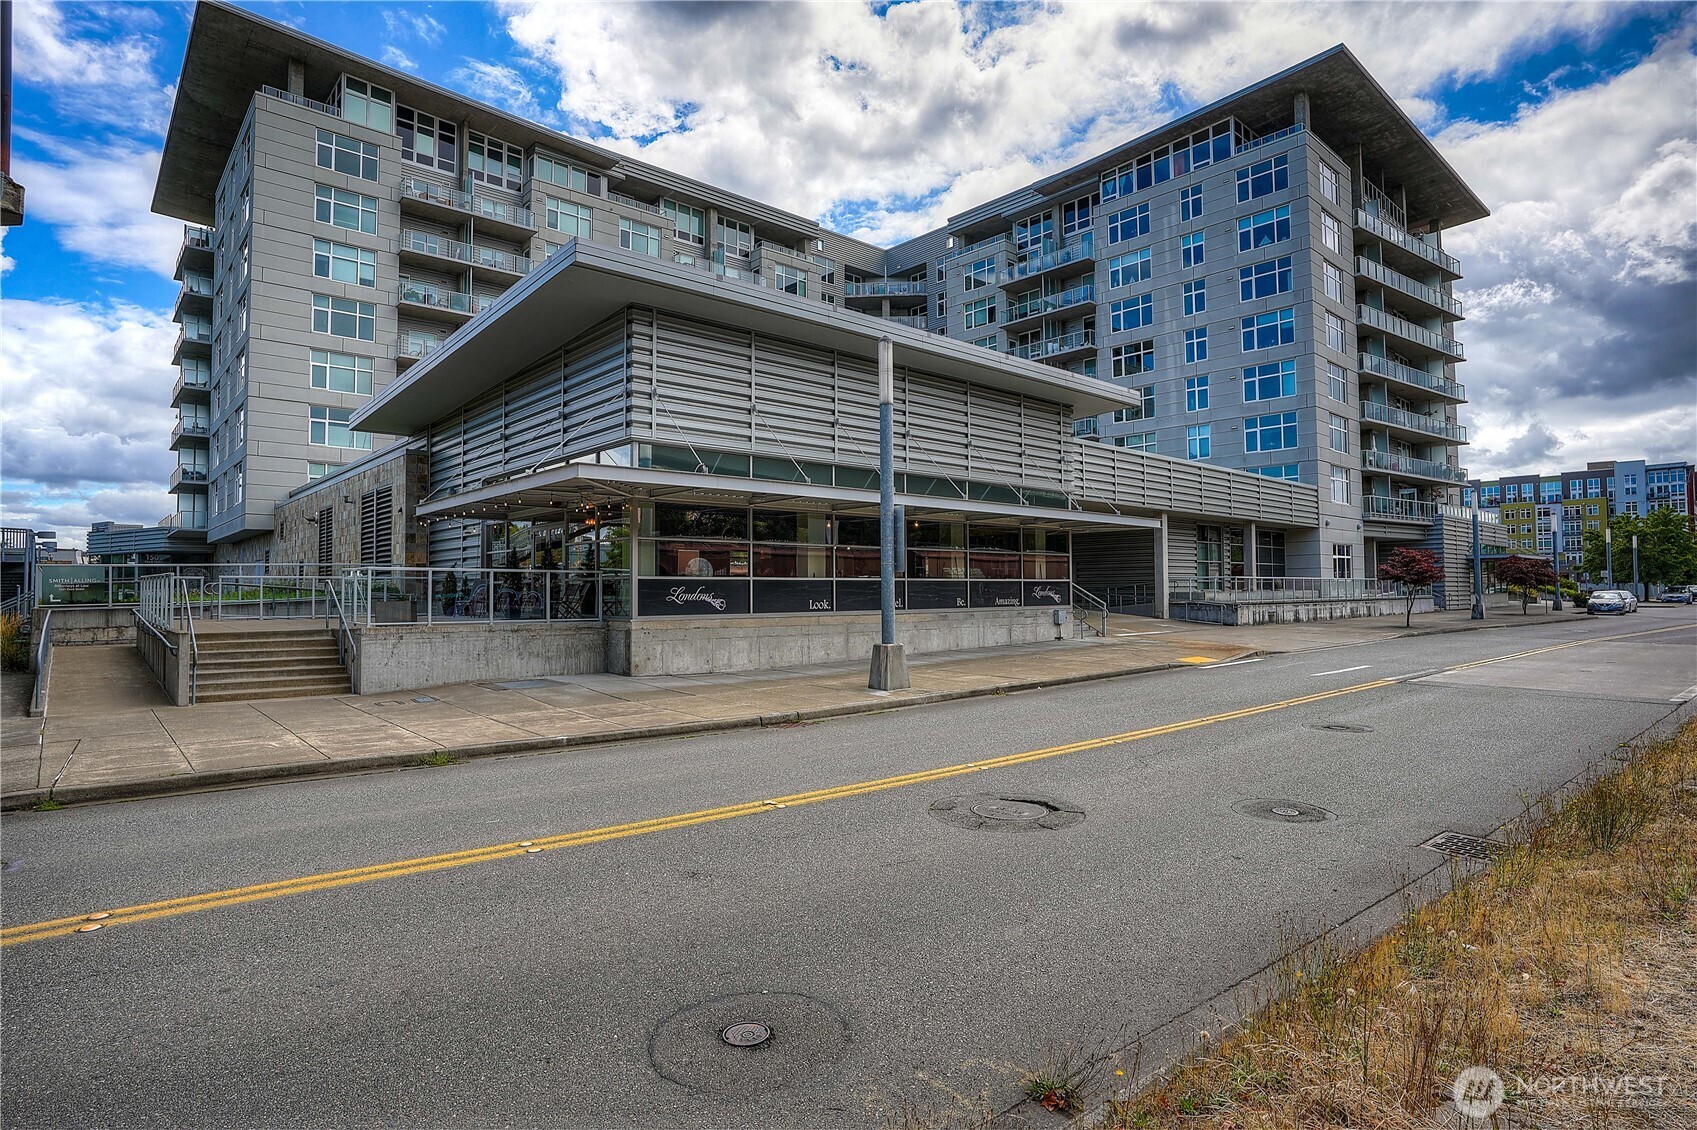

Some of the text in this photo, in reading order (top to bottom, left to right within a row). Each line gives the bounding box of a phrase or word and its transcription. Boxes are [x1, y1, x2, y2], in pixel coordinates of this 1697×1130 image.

[666, 586, 714, 604] Londons
[810, 599, 831, 610] Look.
[957, 597, 966, 607] Be.
